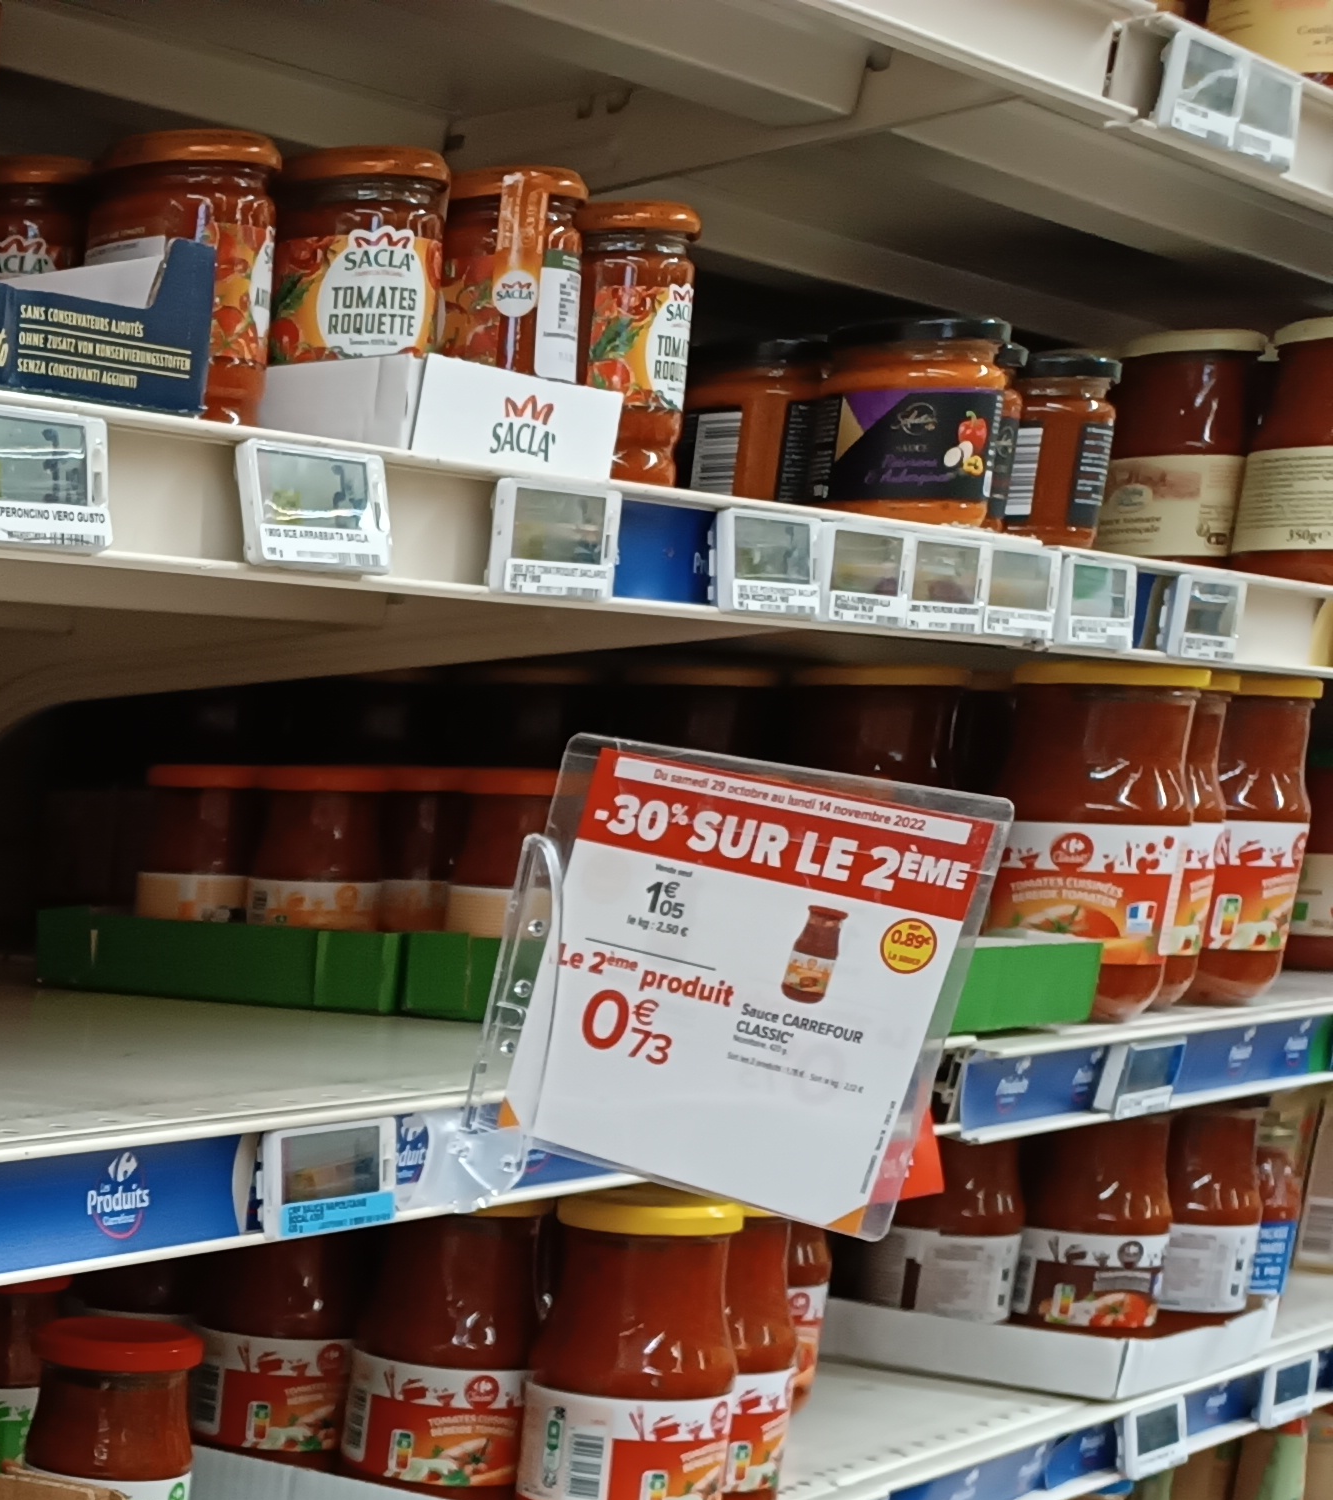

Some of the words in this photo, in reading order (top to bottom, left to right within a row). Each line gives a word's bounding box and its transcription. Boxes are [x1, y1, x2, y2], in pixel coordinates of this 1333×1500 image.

[331, 284, 417, 312] TOMATES
[20, 304, 45, 320] SANS
[48, 307, 109, 331] CONSERVATEURS
[327, 312, 415, 338] ROQUETTE
[18, 333, 44, 348] OHNE
[47, 336, 75, 352] ZUSATZ
[77, 341, 94, 355] VON
[95, 344, 191, 371] KONSERVIERUNGSSTOFFEN
[17, 358, 46, 374] SENZA
[48, 362, 100, 383] CONSERVANTI
[102, 372, 137, 389] AGGIUNTI
[52, 510, 76, 523] VERO
[78, 511, 106, 525] GUSTO
[653, 767, 668, 781] Du
[670, 770, 709, 789] samedi
[711, 779, 726, 792] 29
[728, 781, 768, 801] octobre
[771, 793, 785, 804] au
[788, 793, 815, 811] lundi
[818, 800, 831, 812] 14
[834, 803, 891, 826] novembre
[893, 814, 926, 831] 2022
[594, 793, 688, 842] -30%
[687, 811, 789, 868] SUR
[795, 831, 858, 882] LE
[638, 969, 734, 1008] produit
[741, 1002, 780, 1024] Sauce
[782, 1013, 864, 1044] CARREFOUR
[87, 1183, 150, 1216] Produits
